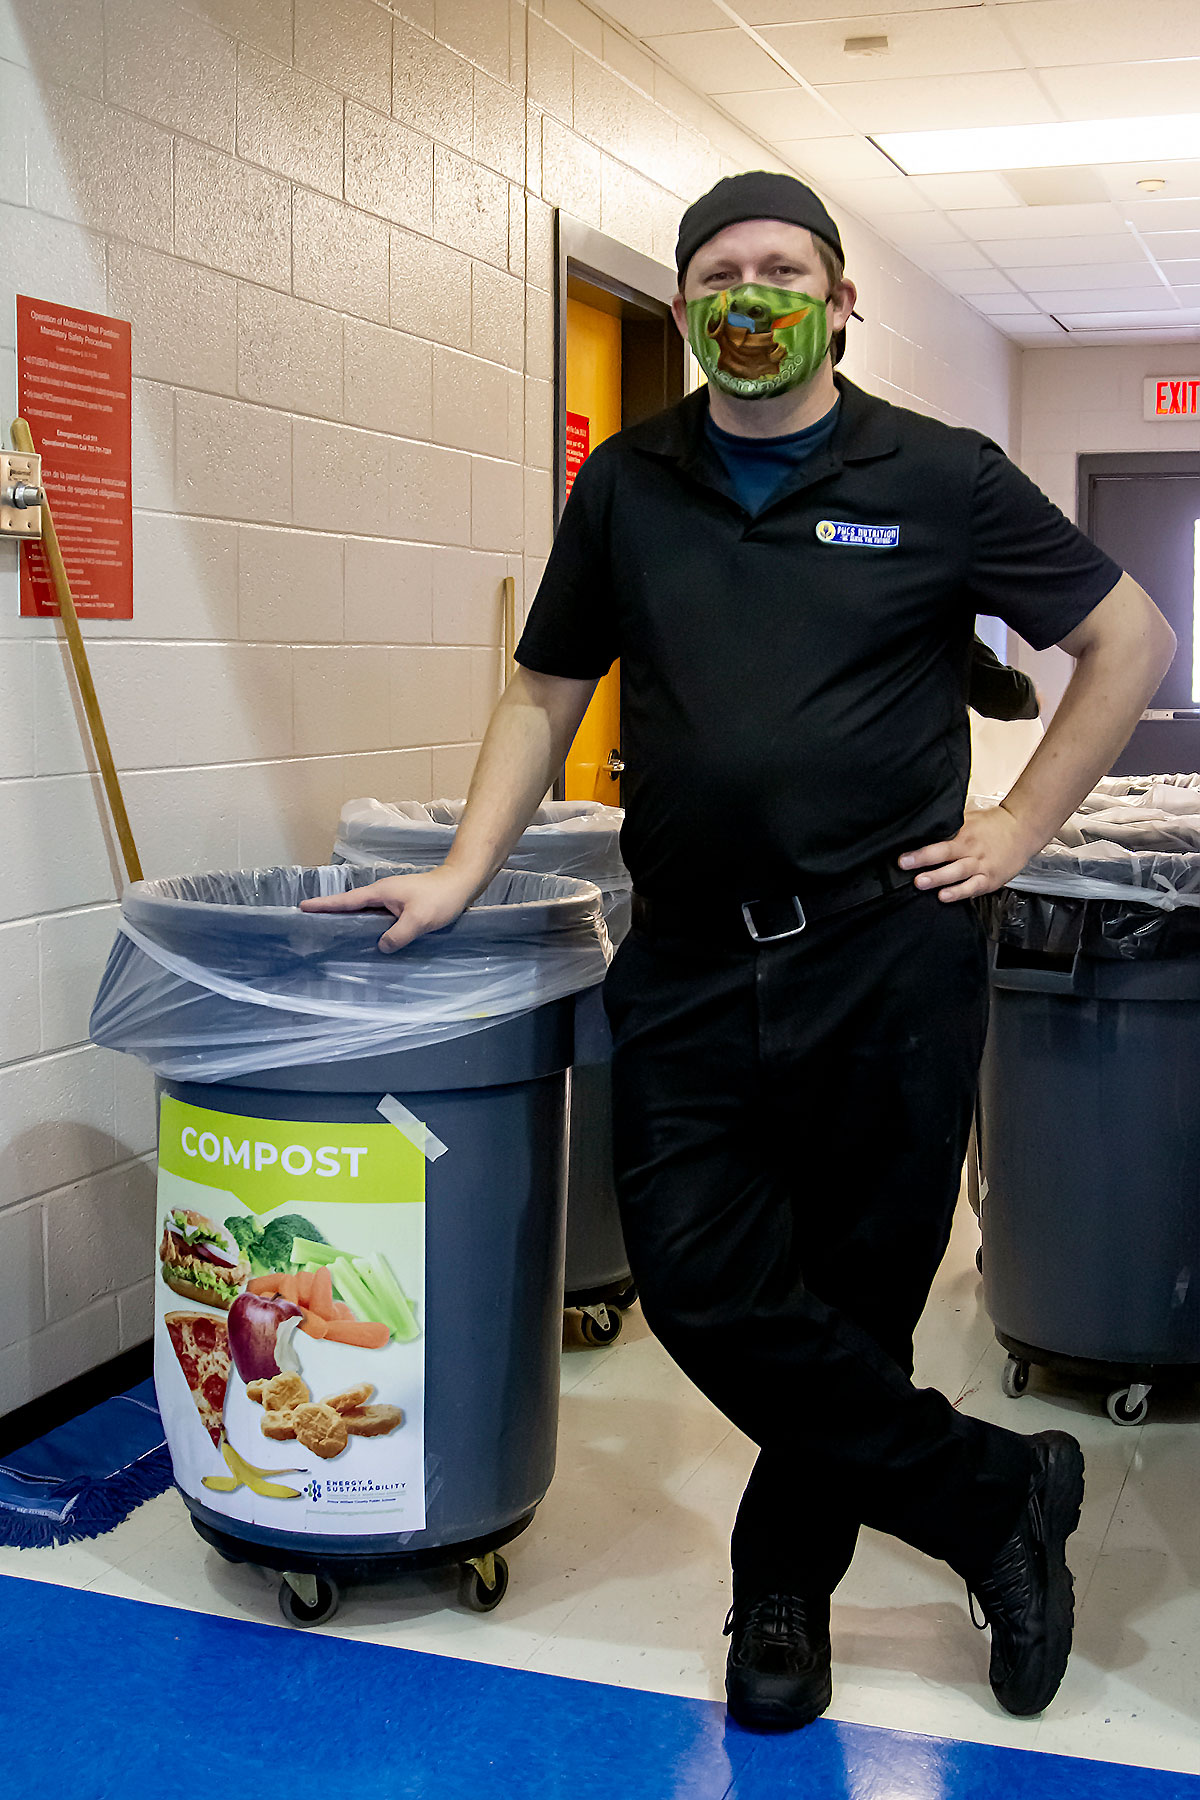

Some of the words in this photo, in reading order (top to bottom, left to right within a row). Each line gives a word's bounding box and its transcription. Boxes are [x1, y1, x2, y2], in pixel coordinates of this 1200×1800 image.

[1156, 381, 1200, 414] EXIT
[858, 528, 896, 538] NUTRITION
[181, 1126, 368, 1178] COMPOST
[326, 1482, 406, 1492] SUSTAINABILITY
